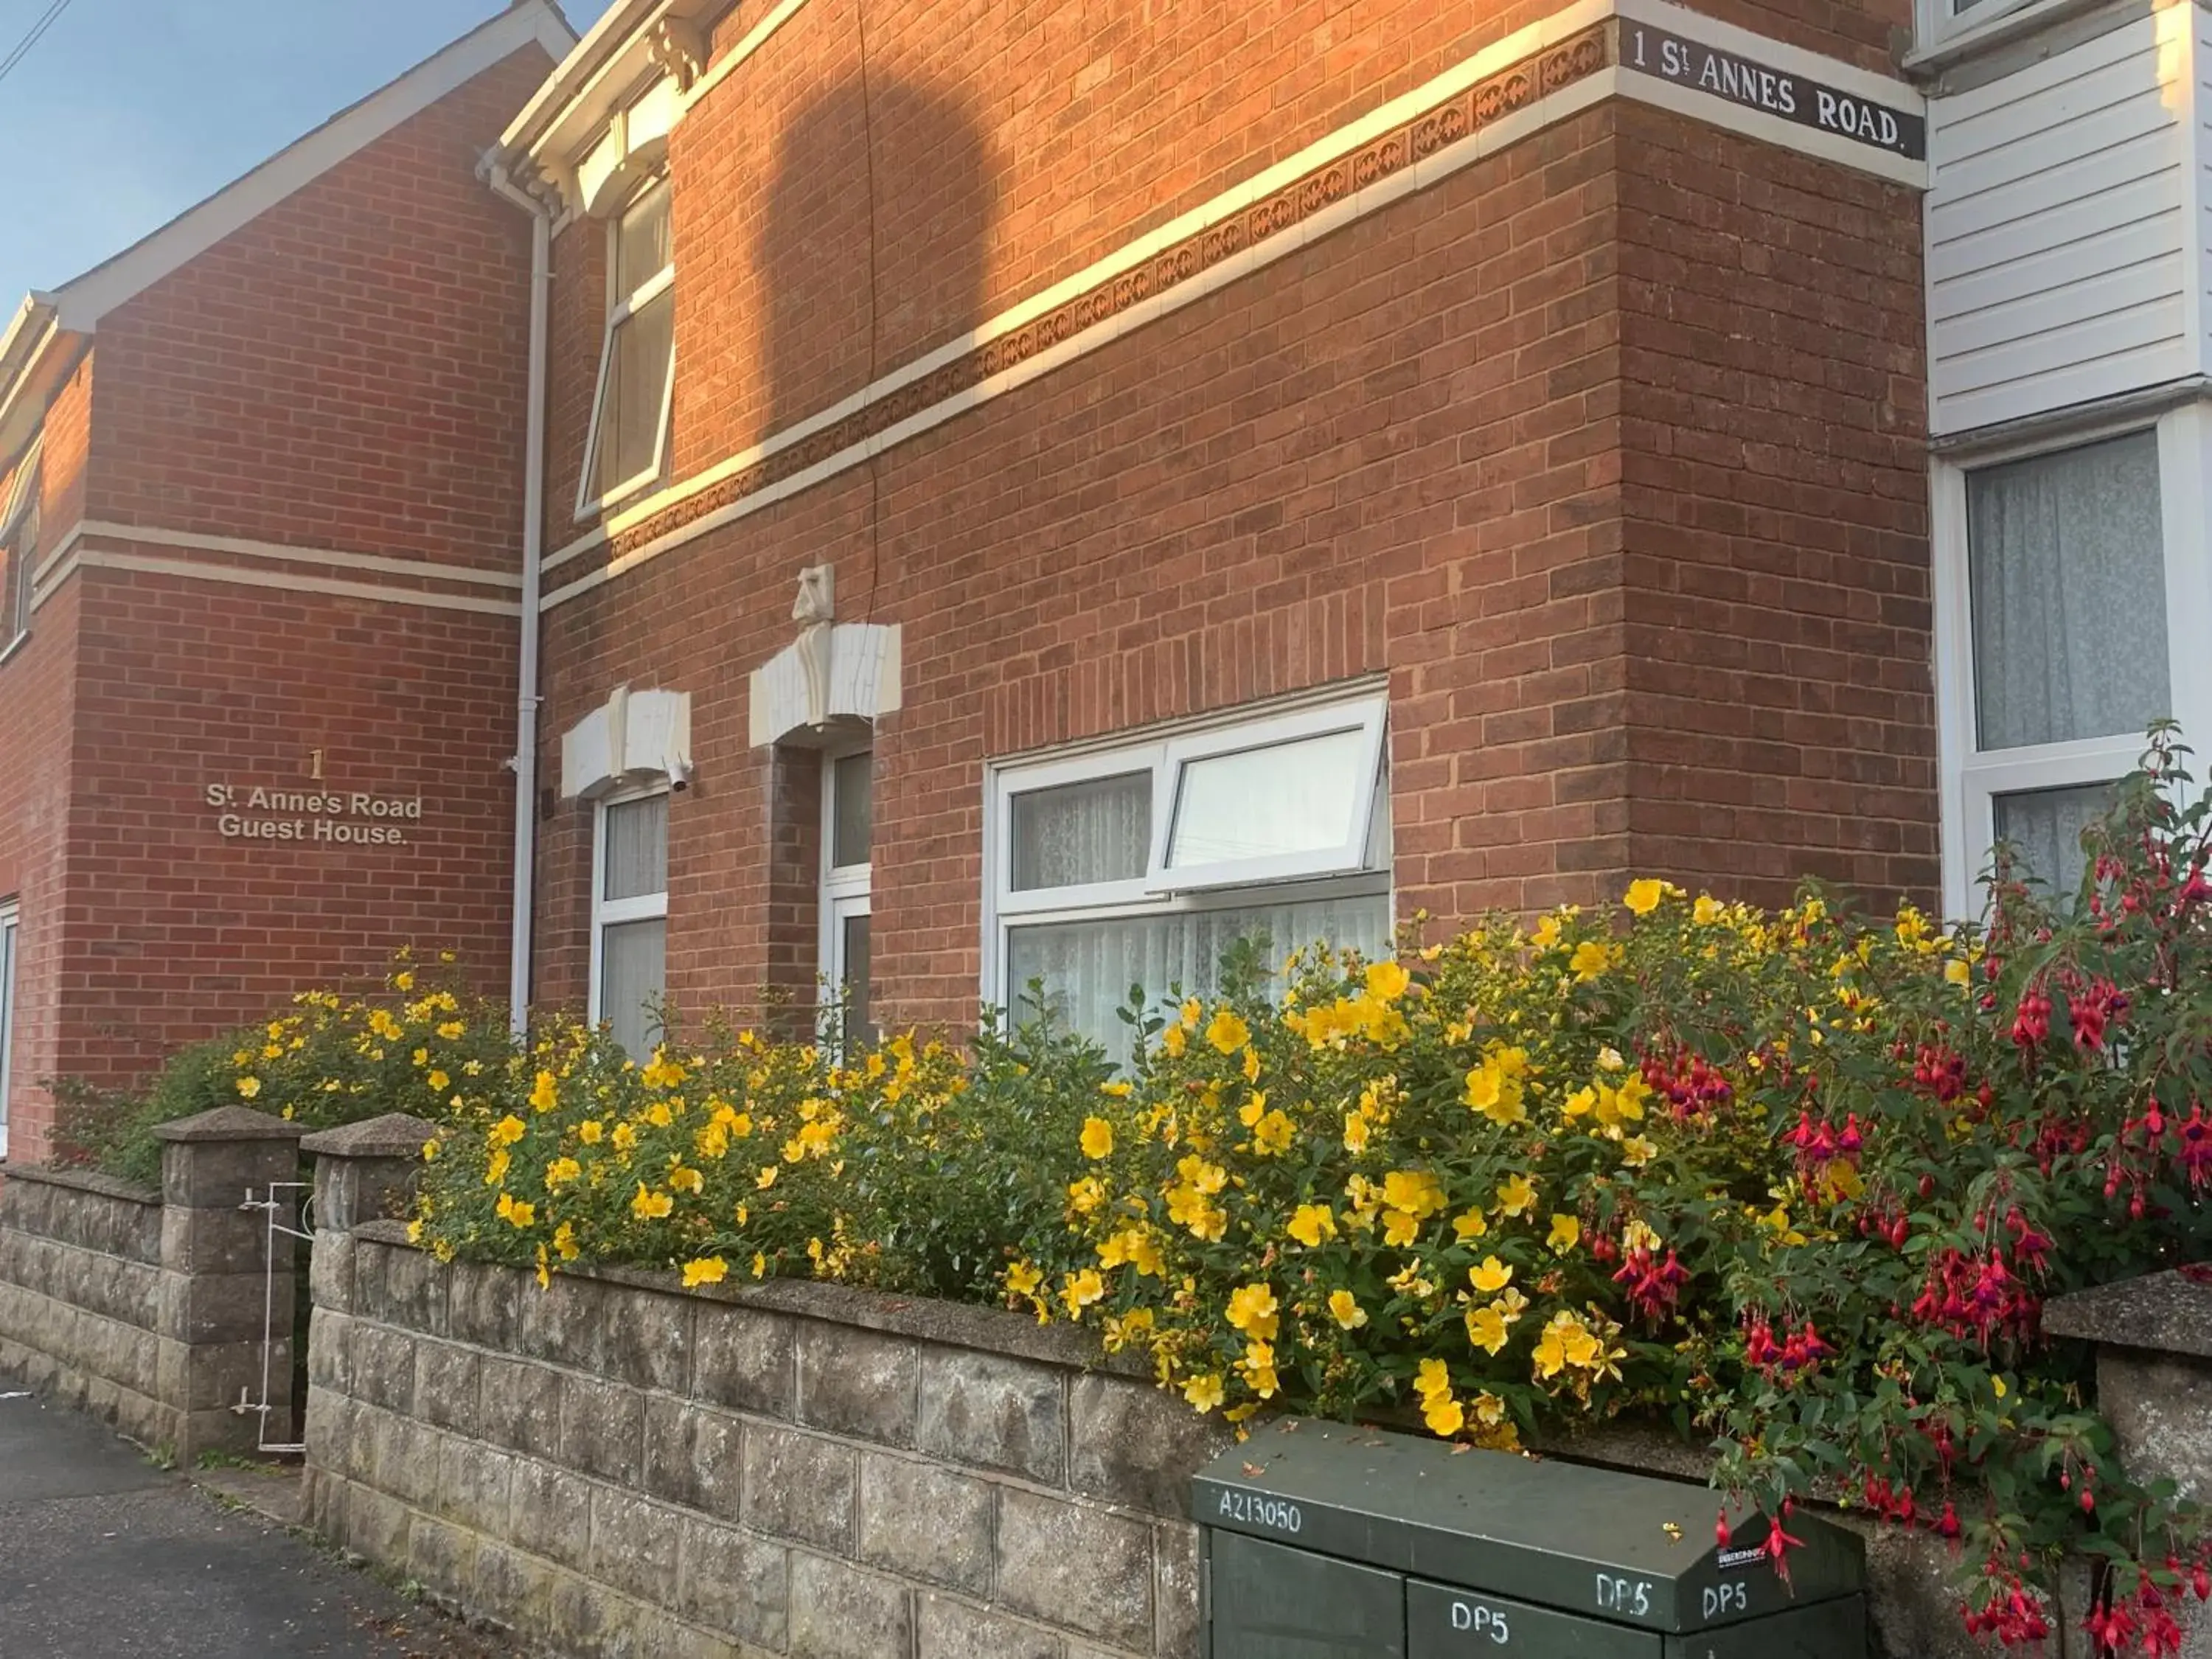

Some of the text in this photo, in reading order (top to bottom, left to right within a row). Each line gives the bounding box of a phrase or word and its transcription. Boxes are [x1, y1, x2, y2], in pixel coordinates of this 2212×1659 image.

[1634, 30, 1646, 67] 1
[1698, 55, 1796, 114] ANNES
[309, 748, 324, 780] 1
[247, 787, 342, 814] Anne's
[350, 793, 422, 818] Road
[218, 813, 408, 845] Guest House.
[1220, 1489, 1301, 1533] A213050
[1703, 1582, 1747, 1620] DP5
[1451, 1601, 1509, 1644] DP5
